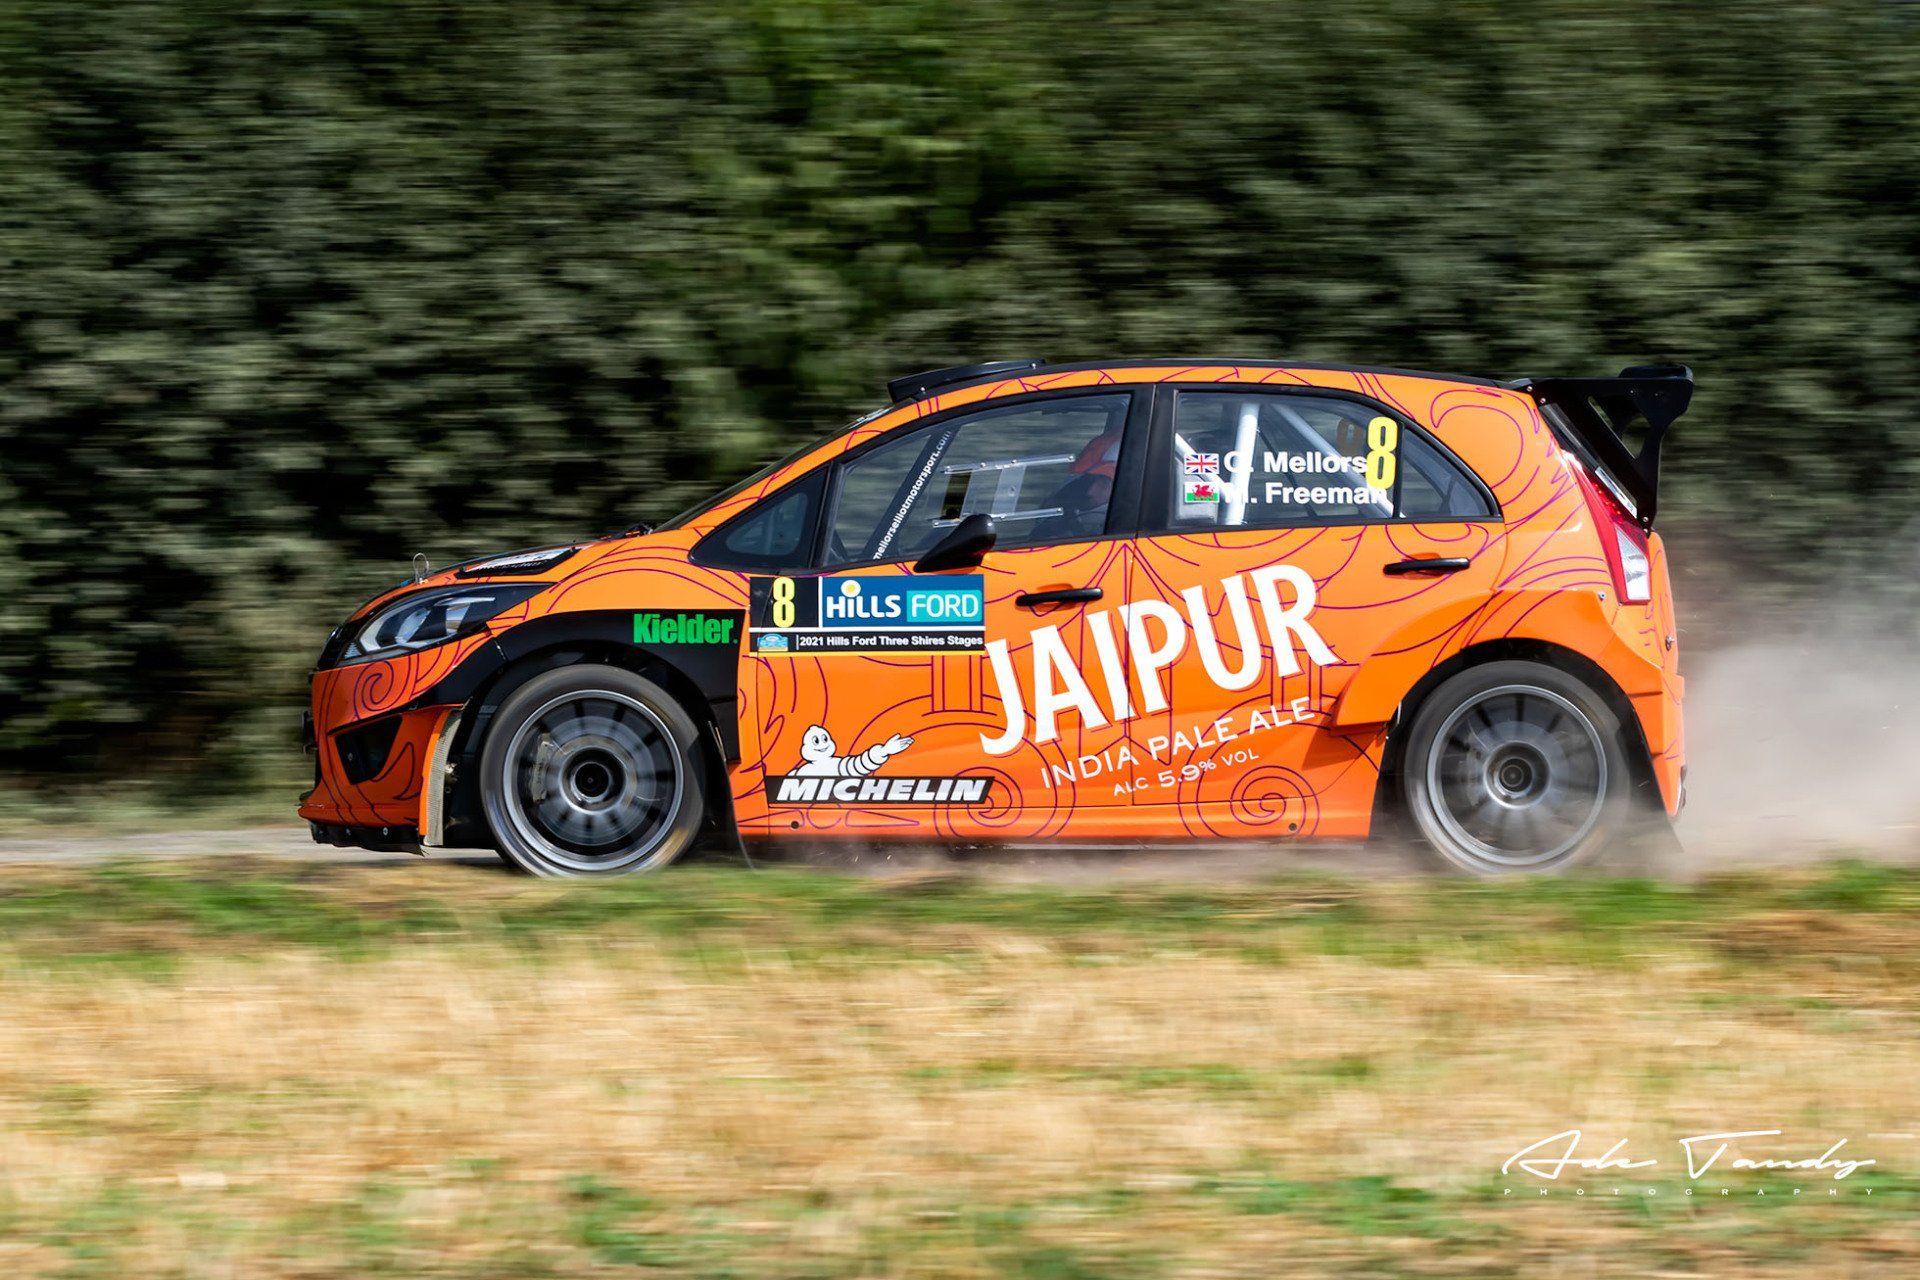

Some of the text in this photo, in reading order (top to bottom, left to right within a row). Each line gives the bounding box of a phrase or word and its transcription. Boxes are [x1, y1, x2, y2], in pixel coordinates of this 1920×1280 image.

[1263, 451, 1367, 473] Mellors
[1366, 416, 1398, 490] 8
[1265, 482, 1387, 504] Freeman
[772, 577, 795, 628] 8
[911, 594, 979, 618] FORD
[800, 636, 823, 646] 2021
[826, 636, 850, 646] Hills
[852, 636, 877, 646] Ford
[879, 635, 908, 646] Three
[911, 635, 945, 646] Shires
[947, 635, 983, 647] Stages
[979, 564, 1341, 755] JAIPUR
[1041, 696, 1315, 789] INDIA PALE ALE
[776, 778, 987, 801] MICHELIN
[1113, 748, 1259, 797] ALC 5.9% VOL
